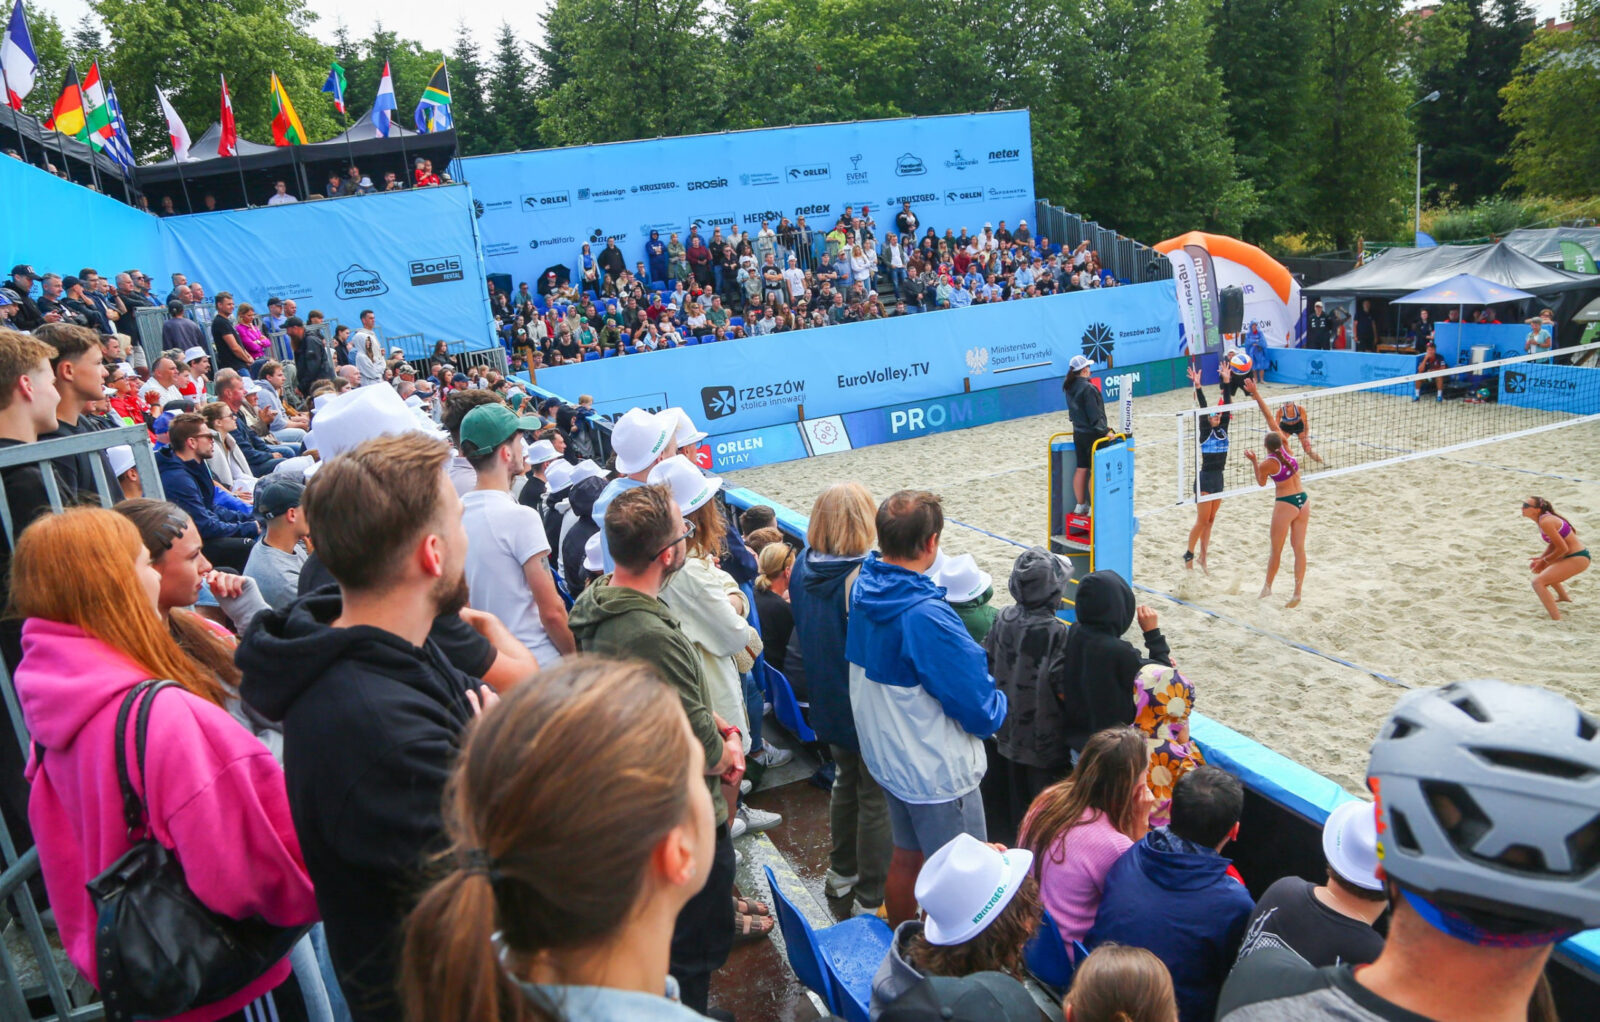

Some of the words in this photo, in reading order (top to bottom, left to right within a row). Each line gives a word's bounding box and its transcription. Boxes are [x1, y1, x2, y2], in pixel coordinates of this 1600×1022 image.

[988, 149, 1020, 159] netex
[803, 168, 828, 177] ORLEN
[846, 172, 868, 181] EVENT
[639, 182, 675, 192] KRUSZGEO
[540, 195, 568, 205] ORLEN
[896, 193, 936, 204] KRUSZGEO
[960, 191, 982, 200] ORLEN
[795, 204, 830, 215] netex
[707, 217, 734, 227] ORLEN
[411, 259, 460, 275] Boels
[443, 272, 462, 281] RENTAL
[991, 341, 1037, 354] Ministerstwo
[991, 354, 1016, 366] Sportu
[1021, 349, 1053, 362] Turystyki
[837, 362, 930, 388] EuroVolley.TV
[1105, 372, 1140, 386] ORN
[1528, 376, 1577, 391] rzeszów
[739, 380, 805, 401] rzeszów
[741, 401, 767, 411] stolica
[769, 394, 807, 405] innowacji
[717, 437, 763, 455] ORLEN
[718, 453, 750, 466] VITAY
[972, 886, 1005, 925] KRUSZGEO
